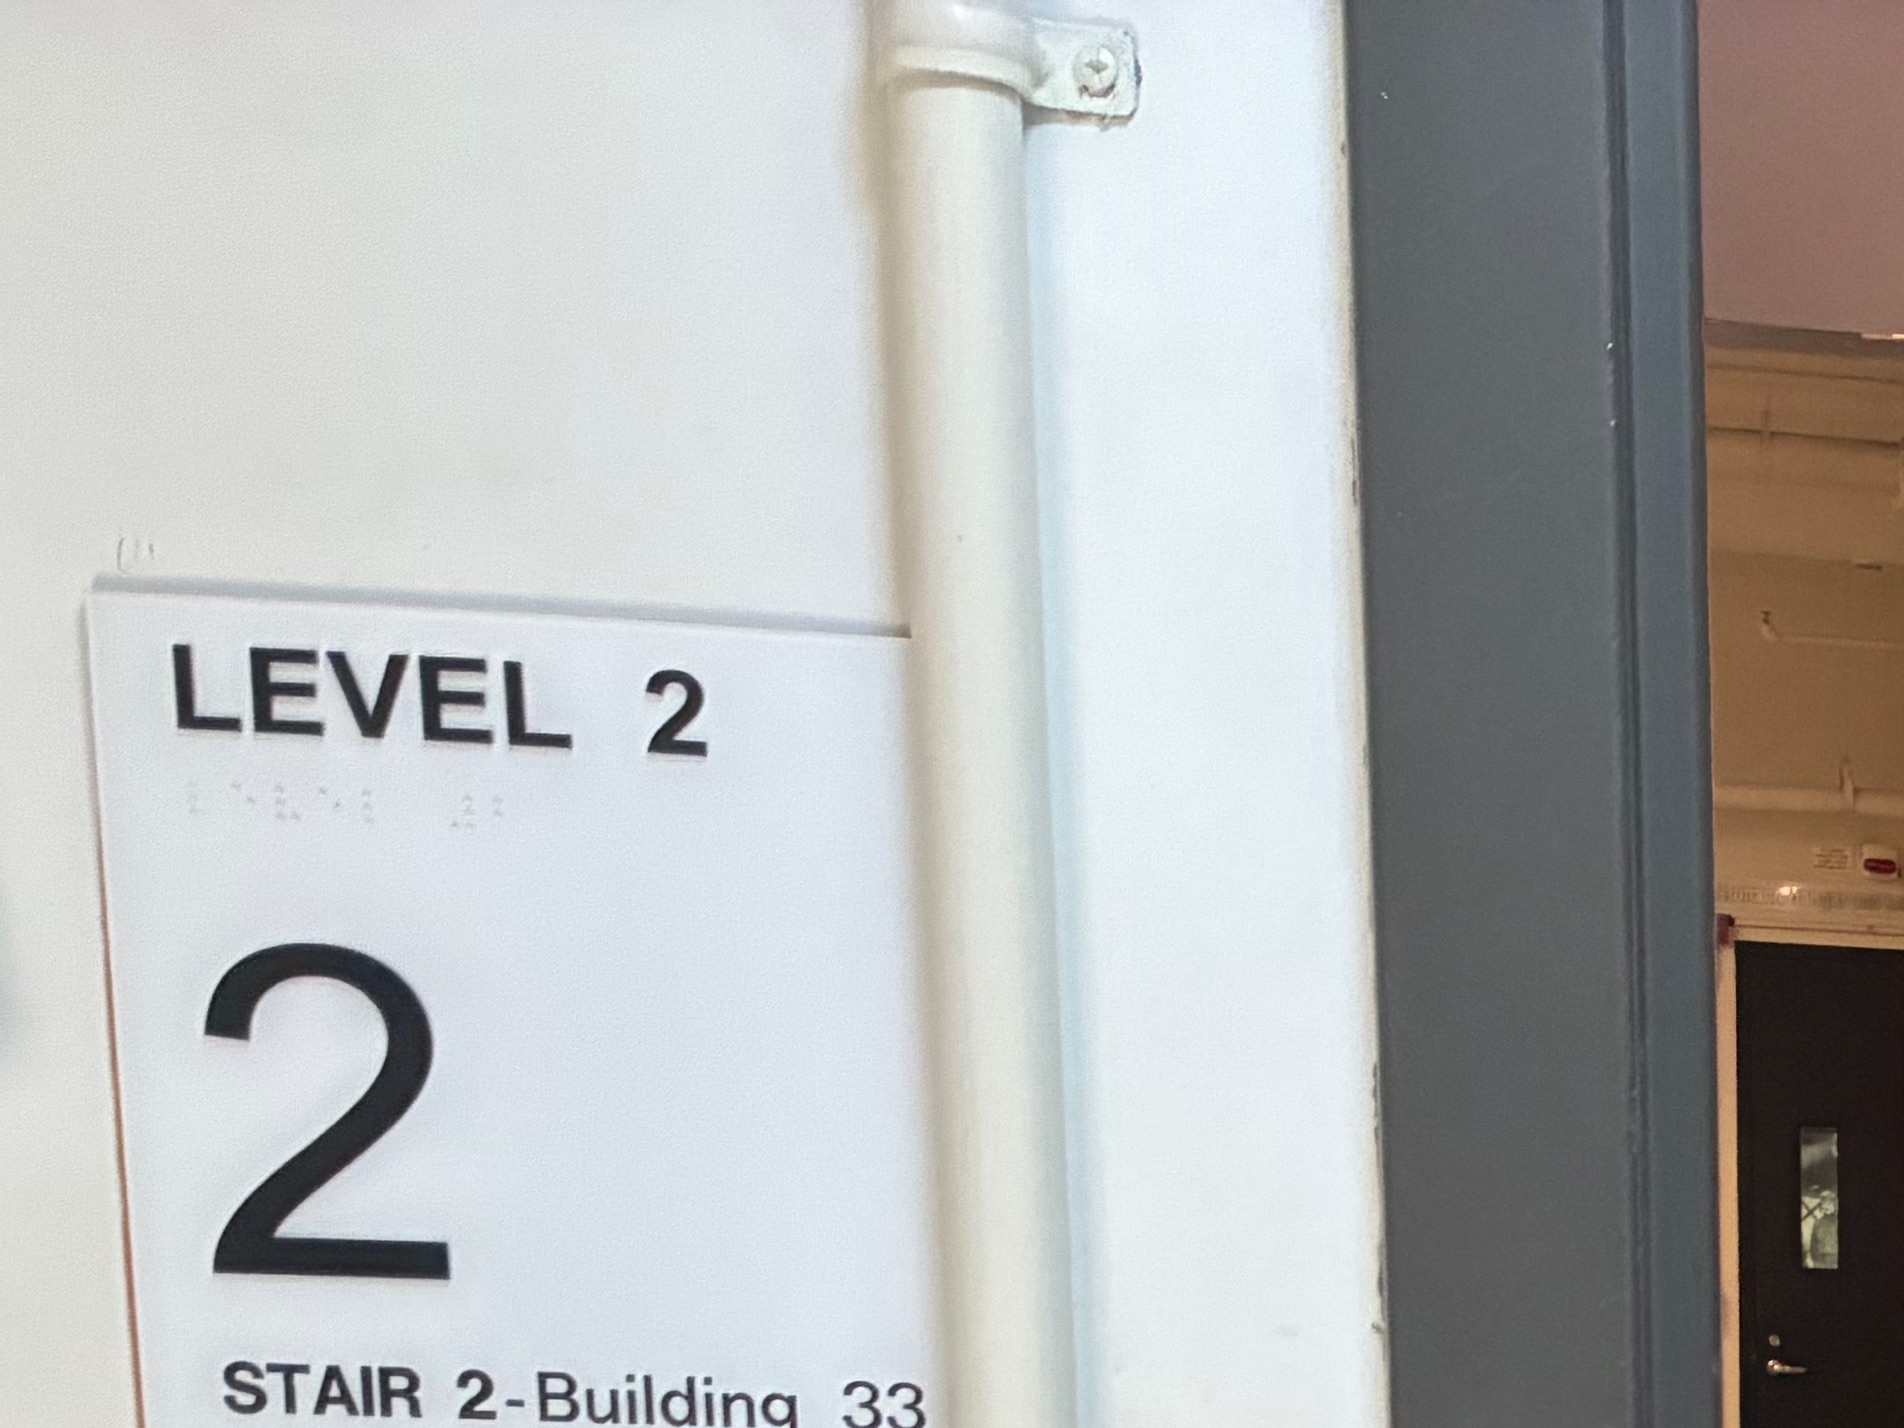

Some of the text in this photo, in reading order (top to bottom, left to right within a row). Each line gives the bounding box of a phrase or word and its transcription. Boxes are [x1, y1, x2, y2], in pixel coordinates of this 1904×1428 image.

[173, 644, 707, 757] LEVEL 2
[205, 943, 450, 1280] 2
[224, 1361, 422, 1418] STAIR
